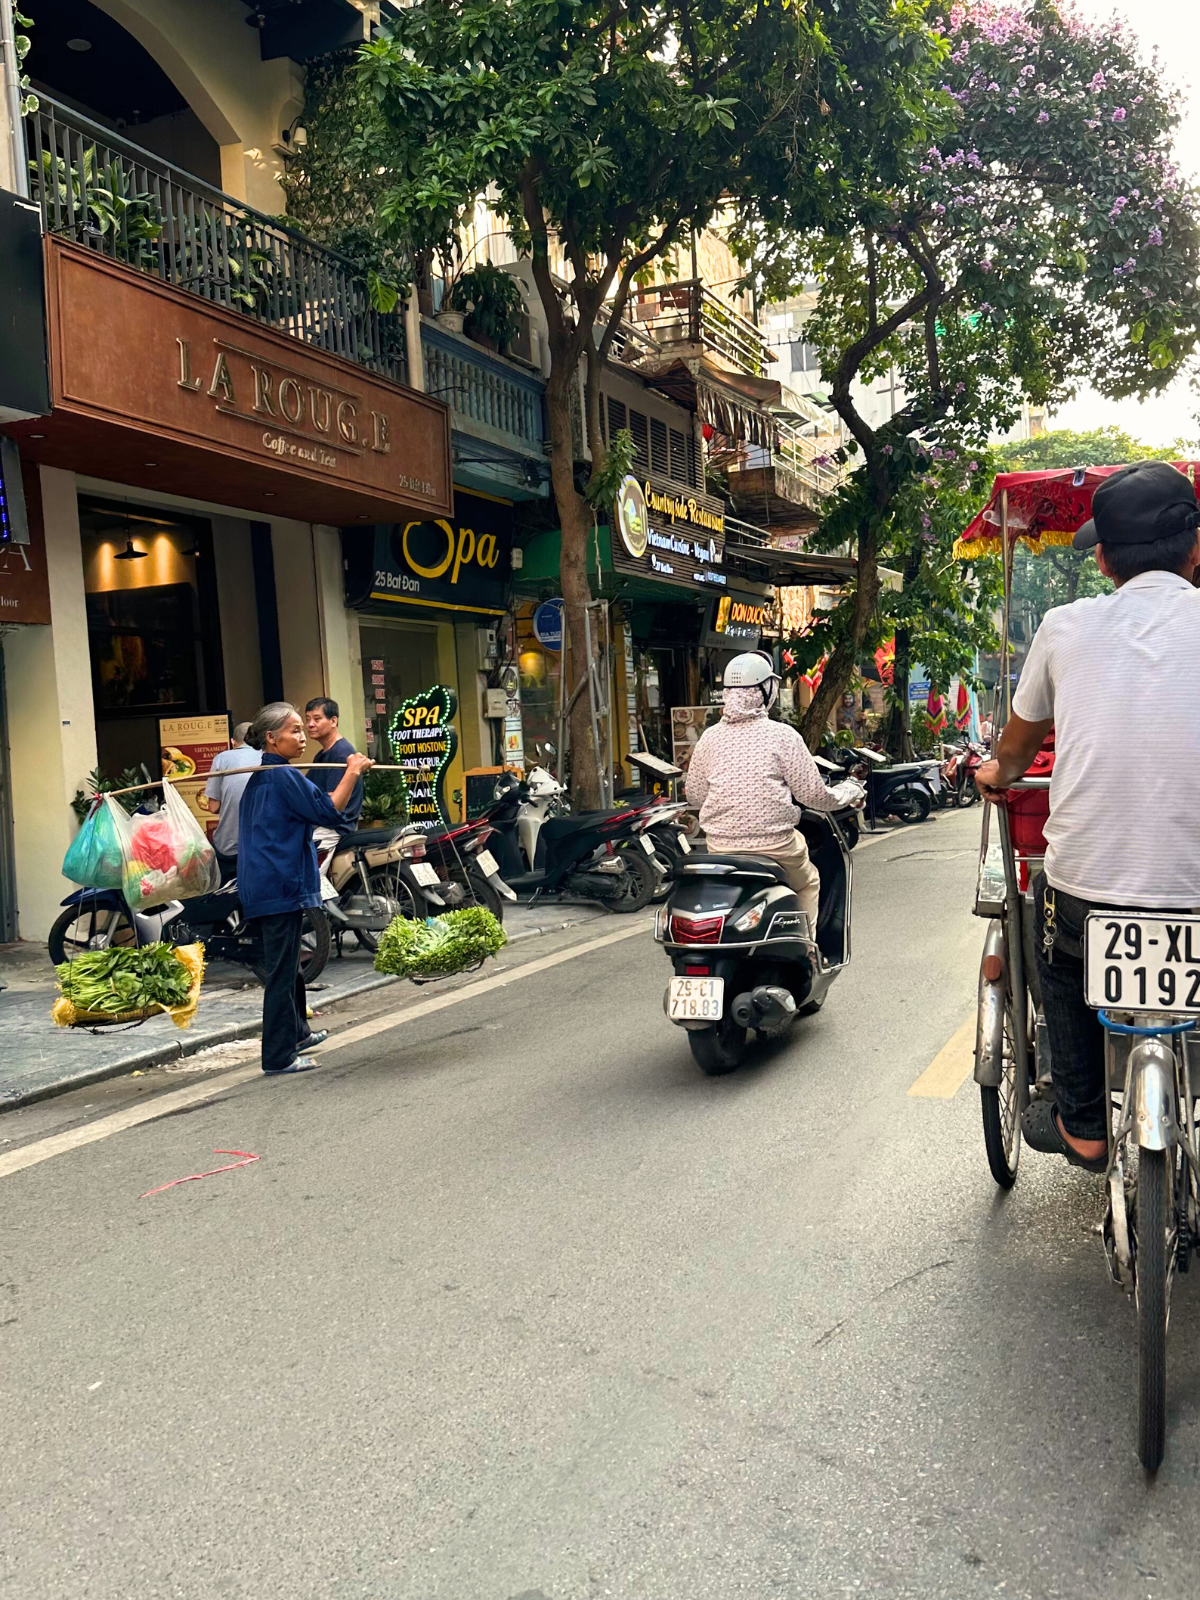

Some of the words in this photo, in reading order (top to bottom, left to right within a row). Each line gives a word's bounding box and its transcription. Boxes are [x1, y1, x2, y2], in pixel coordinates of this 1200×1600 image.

[176, 337, 236, 403] LA
[250, 365, 391, 454] ROUG.E
[262, 432, 296, 456] Coffee
[297, 446, 317, 462] and
[319, 449, 337, 468] Tea
[645, 481, 688, 524] Countryside
[687, 498, 725, 533] Restaurant
[402, 519, 500, 584] Opa
[375, 570, 386, 588] 25
[387, 572, 402, 590] Bat
[401, 575, 420, 593] Đan
[0, 595, 19, 608] loor
[731, 602, 748, 623] DON
[746, 605, 765, 625] DUCK
[162, 724, 174, 732] LA
[177, 721, 213, 732] ROUG.E
[403, 705, 440, 728] SPA
[393, 730, 411, 742] FOOT
[412, 727, 444, 740] THERAPY
[399, 743, 416, 754] FOOT
[417, 741, 447, 753] HOSTONE
[402, 759, 418, 768] OOT
[418, 756, 440, 768] SCRUB
[410, 803, 437, 815] FACIAL
[1105, 921, 1200, 963] 29-XL
[1105, 965, 1200, 1008] 0192
[672, 998, 719, 1016] 718.83
